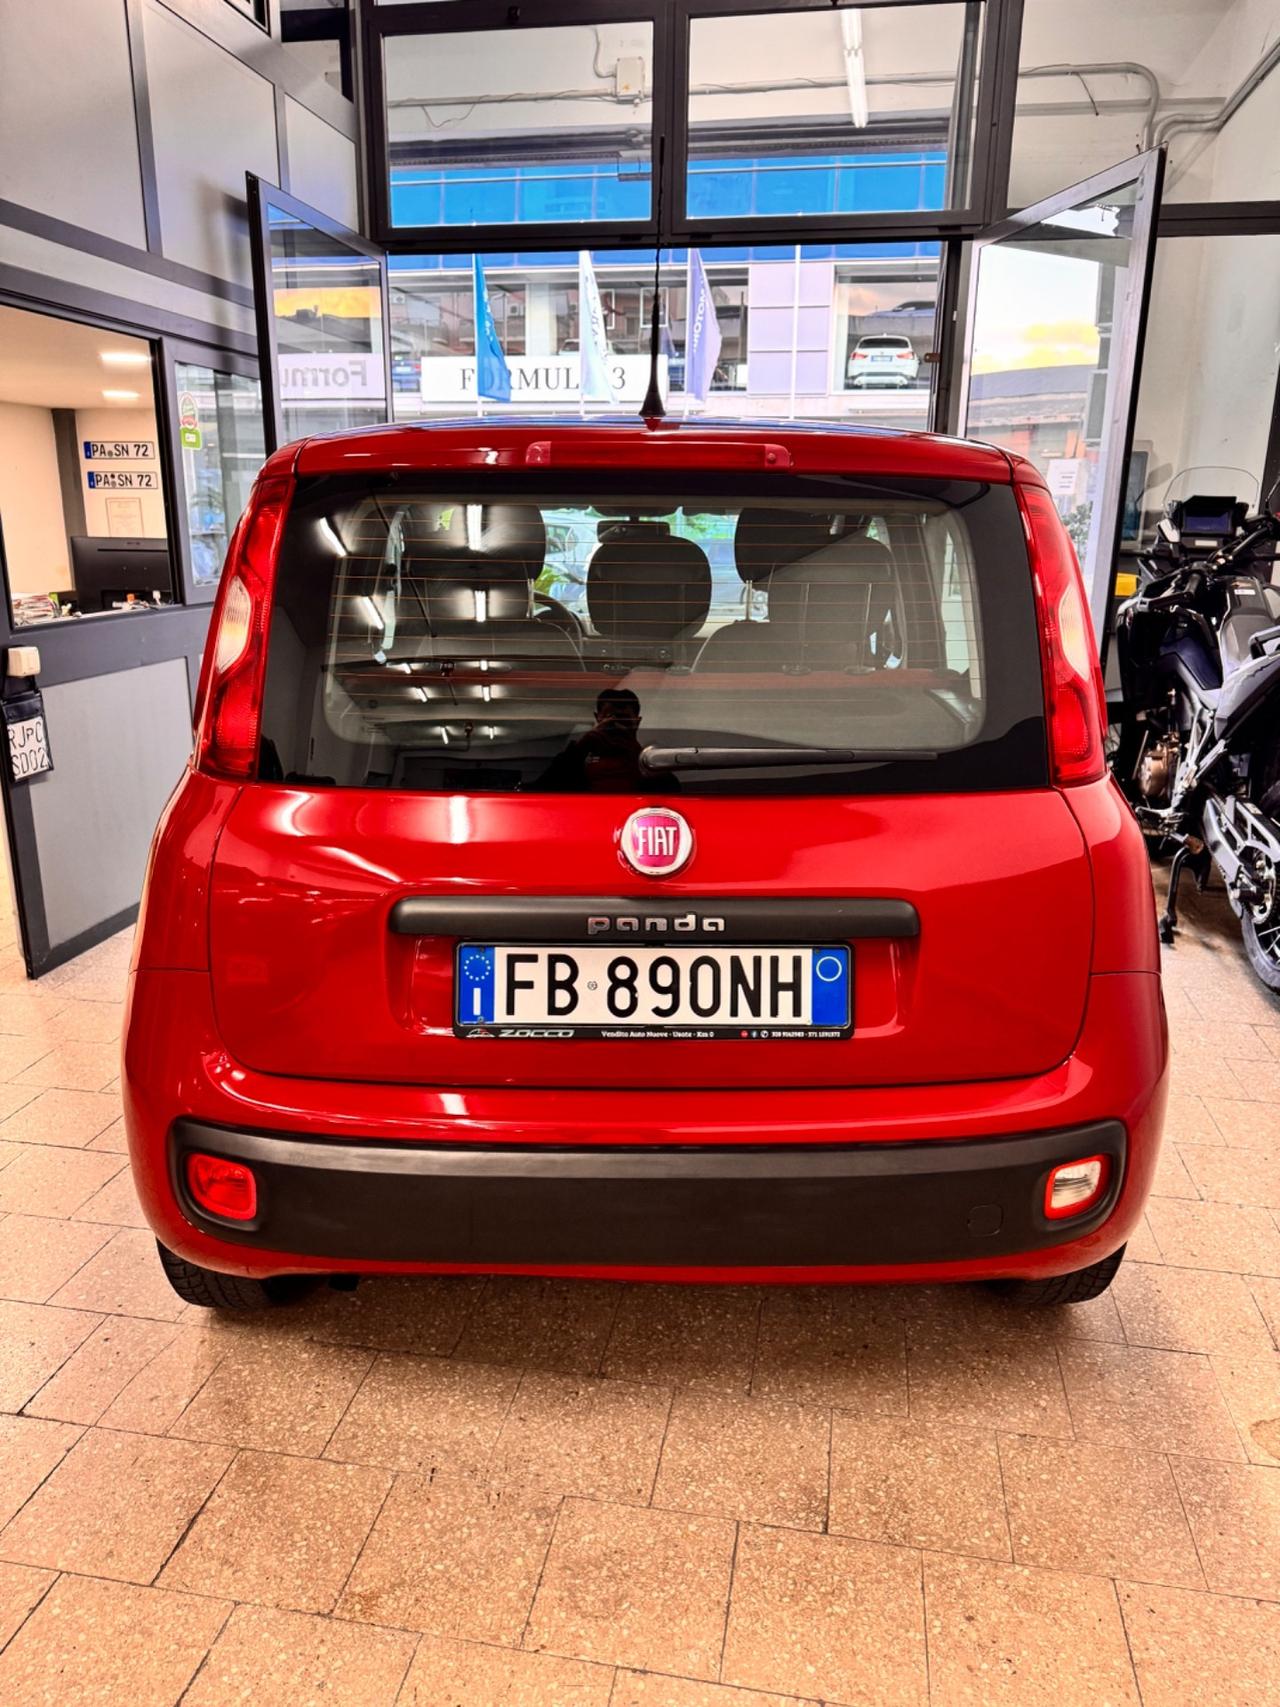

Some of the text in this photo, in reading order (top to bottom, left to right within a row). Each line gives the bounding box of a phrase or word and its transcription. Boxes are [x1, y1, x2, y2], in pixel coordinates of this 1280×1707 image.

[460, 367, 626, 390] FORMUL 3
[92, 444, 149, 456] PA SN 72
[95, 474, 152, 487] PA SN 72
[637, 826, 678, 856] FIAT
[587, 914, 725, 935] panda
[506, 954, 802, 1018] FB 890NH
